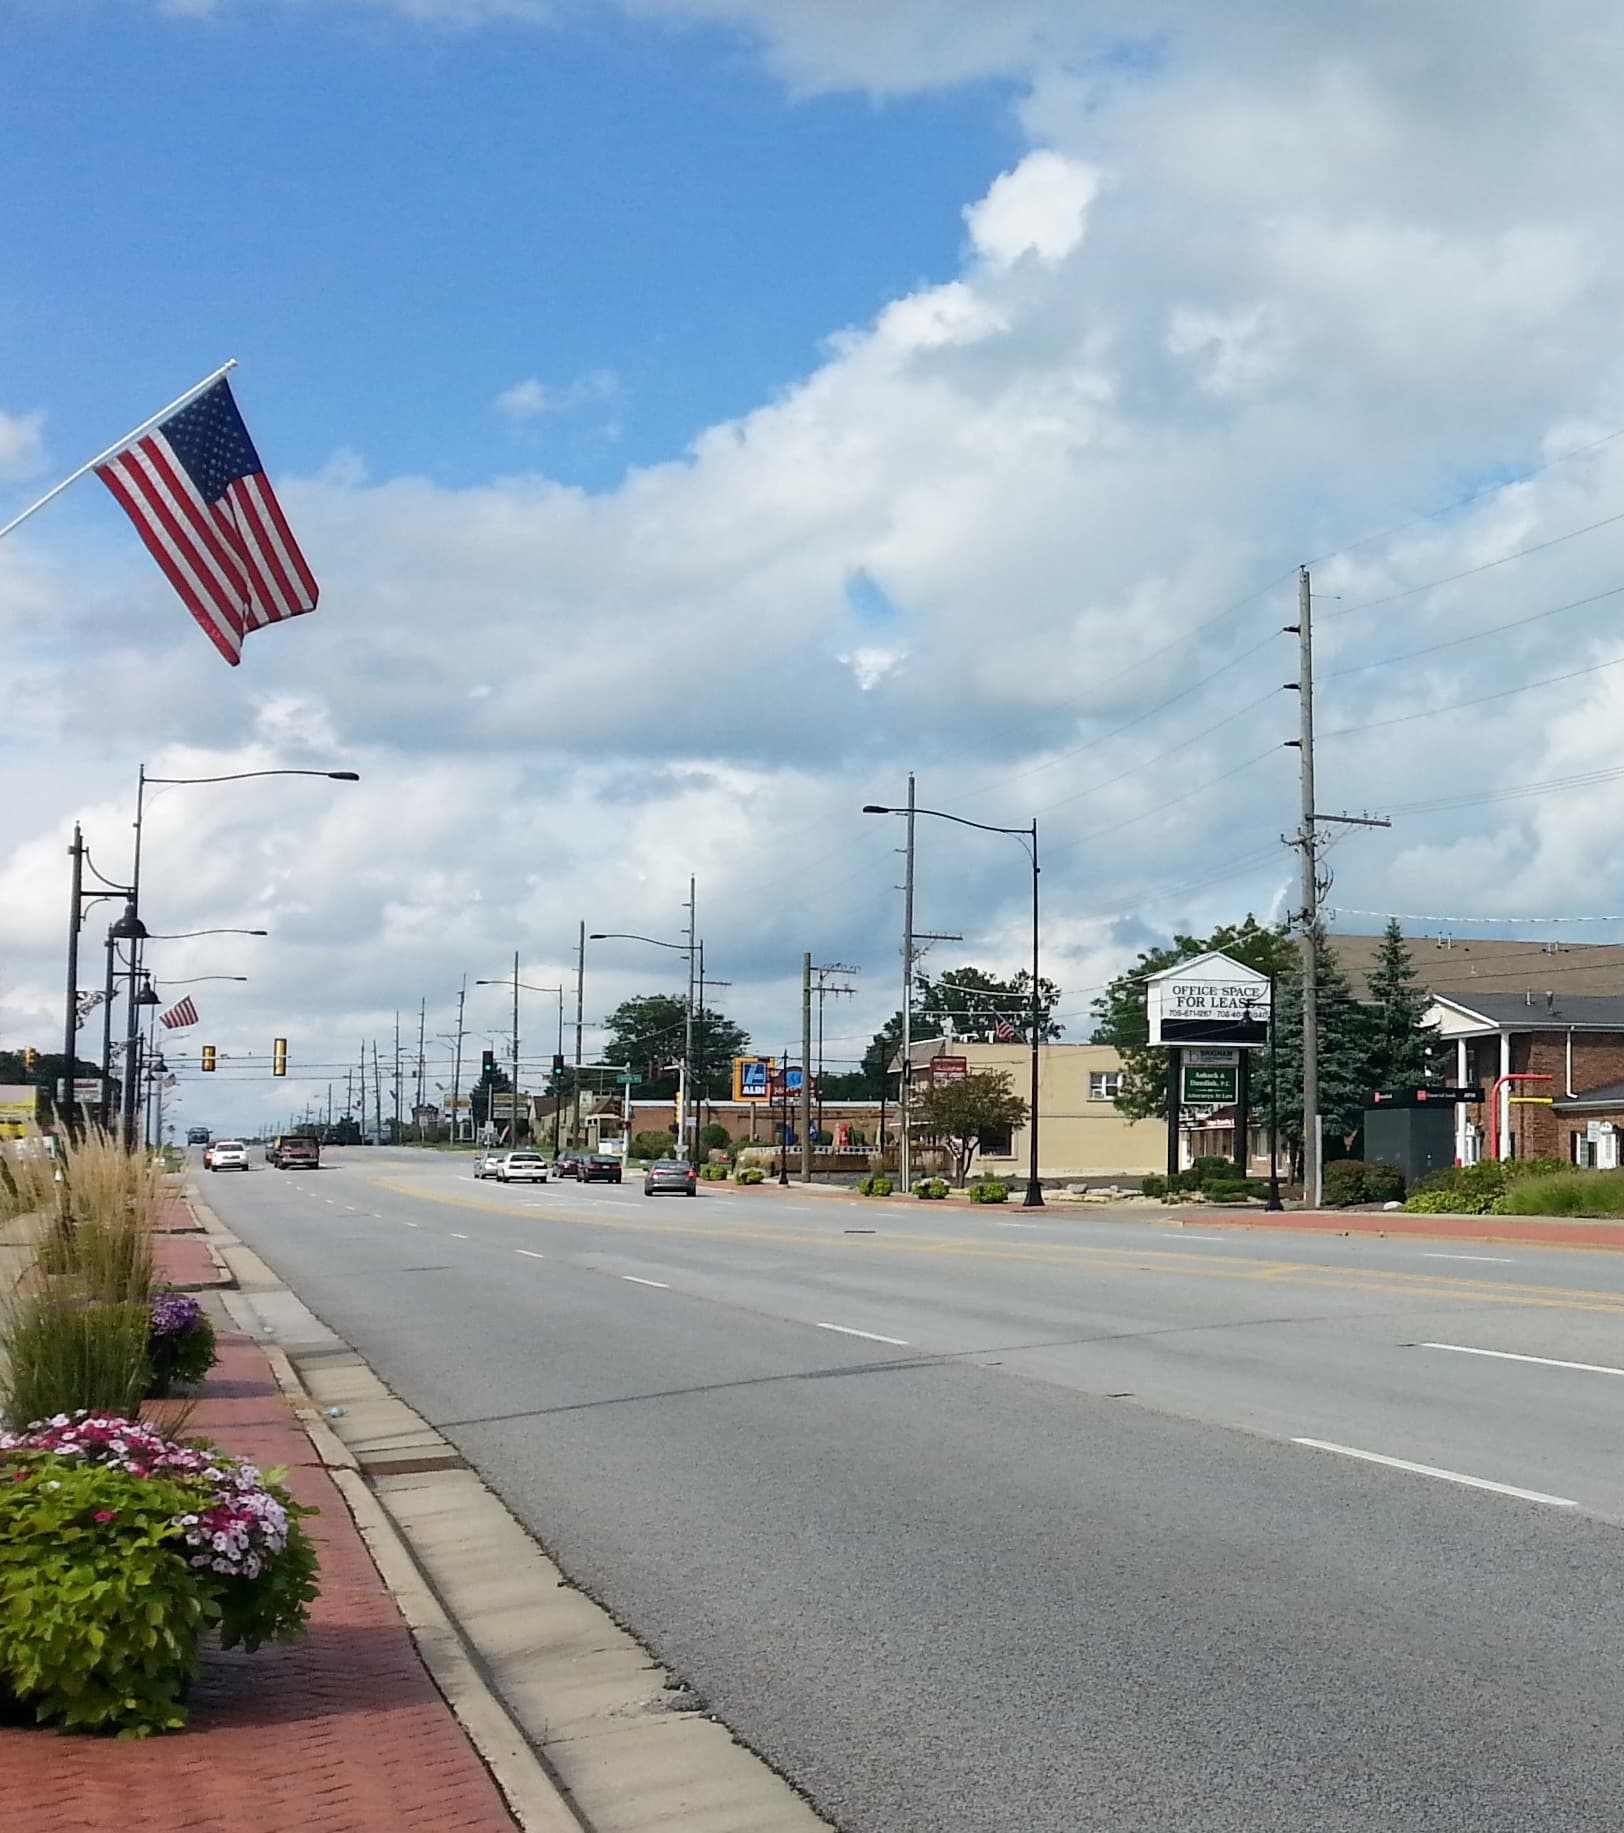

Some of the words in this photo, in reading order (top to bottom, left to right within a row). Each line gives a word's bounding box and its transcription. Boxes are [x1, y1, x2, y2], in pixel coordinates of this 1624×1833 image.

[1172, 985, 1217, 996] OFFICE
[1222, 986, 1260, 997] SPACE
[1176, 997, 1206, 1008] FOR
[1211, 997, 1255, 1009] LEAS
[742, 1085, 766, 1095] ALDI
